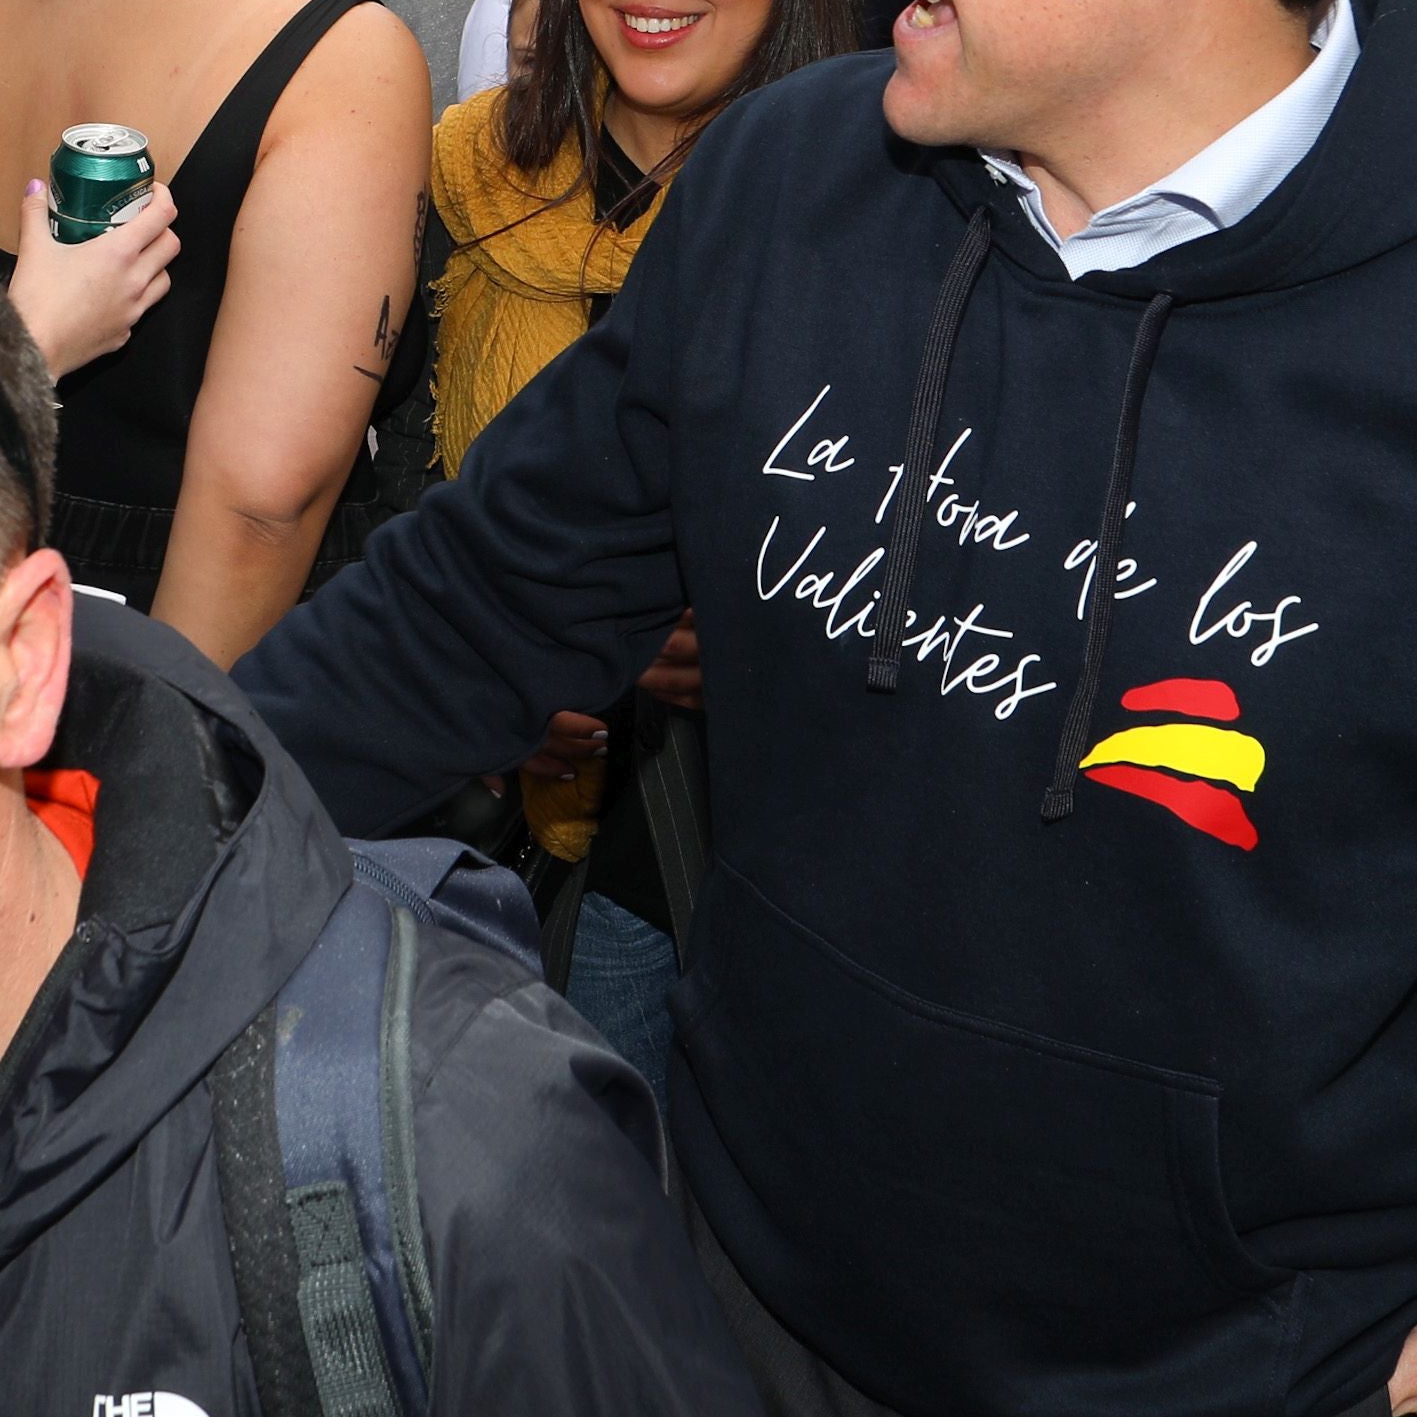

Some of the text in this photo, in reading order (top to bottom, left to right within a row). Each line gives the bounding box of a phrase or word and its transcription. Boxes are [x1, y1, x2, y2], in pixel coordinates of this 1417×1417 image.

[756, 515, 1058, 721] Valientes
[761, 384, 855, 481] La
[1188, 540, 1320, 668] los
